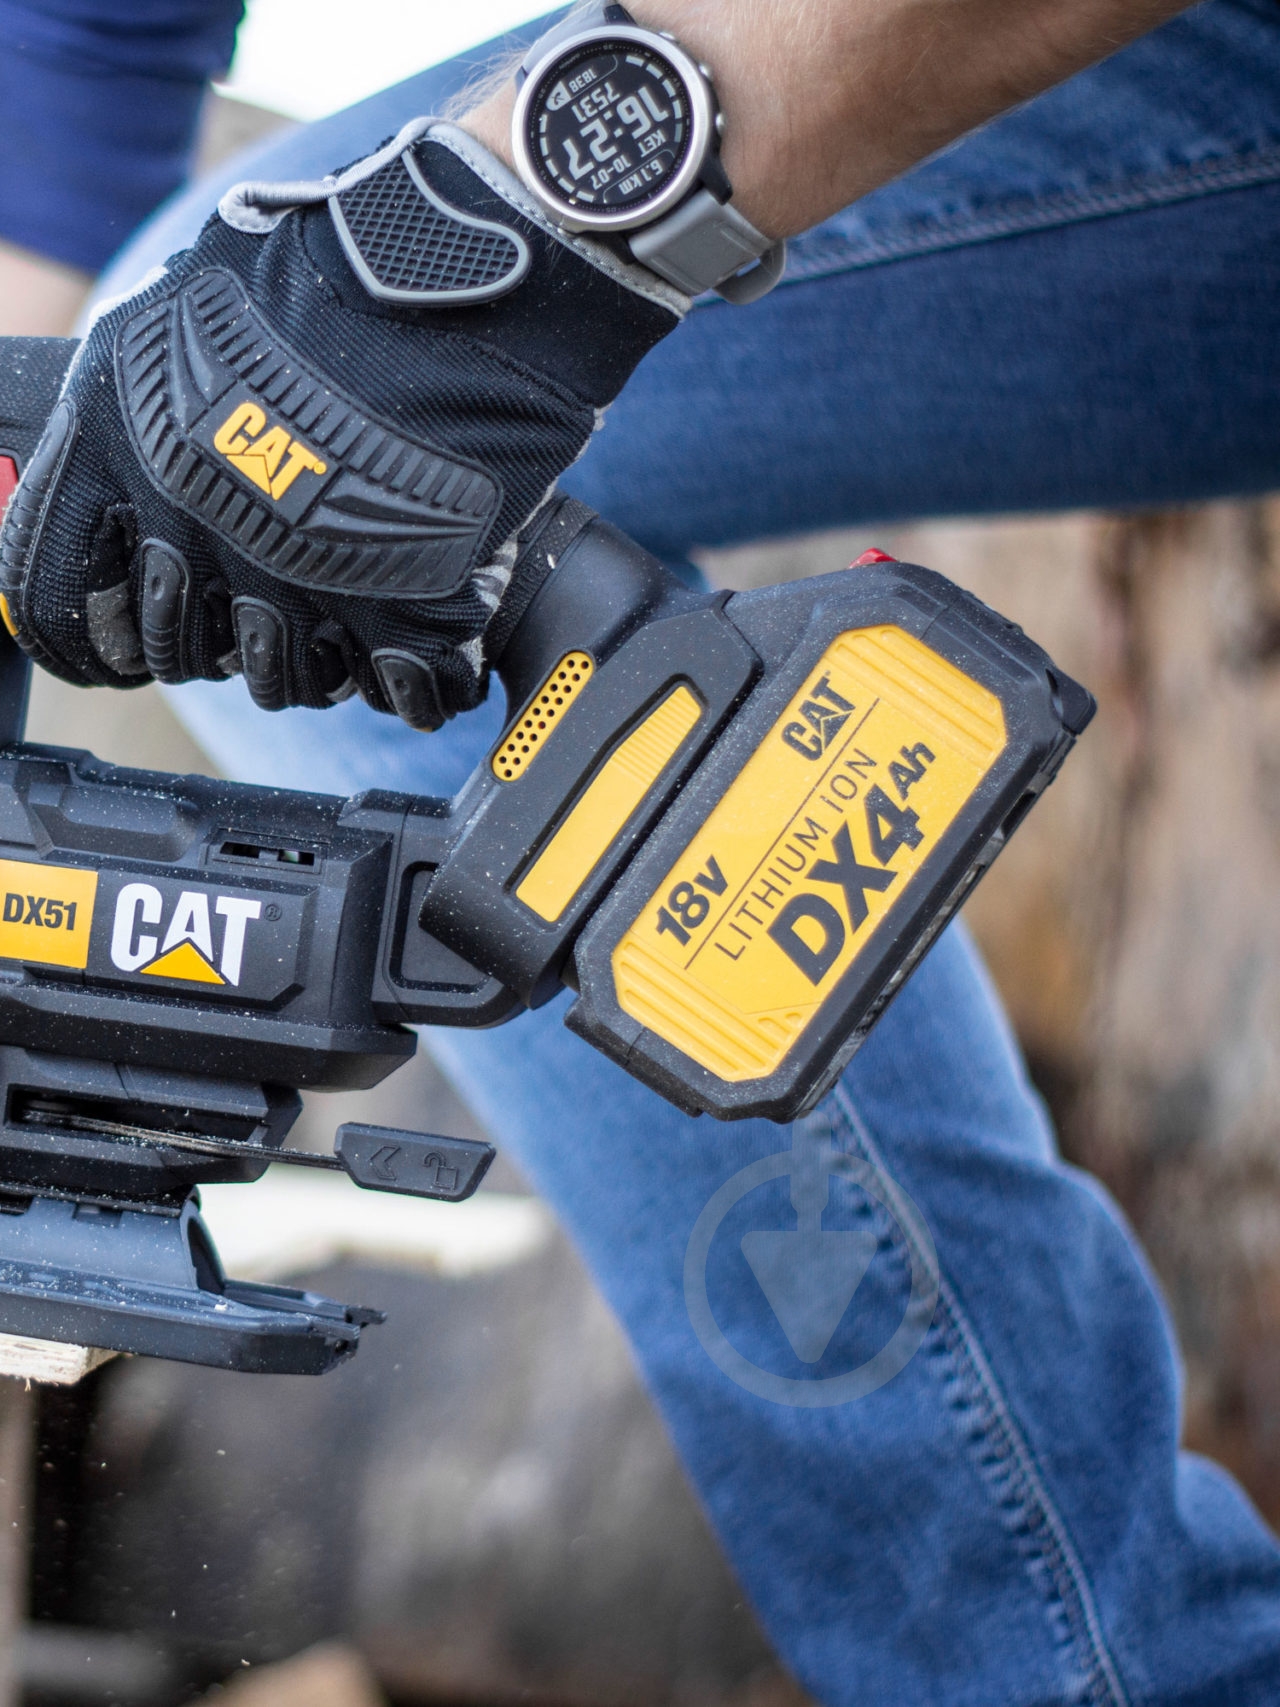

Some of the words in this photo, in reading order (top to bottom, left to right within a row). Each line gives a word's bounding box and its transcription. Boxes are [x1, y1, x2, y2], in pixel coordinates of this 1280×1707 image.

[568, 68, 597, 93] 1838
[571, 81, 621, 123] 7531
[562, 86, 669, 180] 16:27
[637, 129, 666, 158] KET
[591, 155, 632, 190] 10-07
[618, 174, 642, 195] km
[640, 159, 663, 181] 6.1
[214, 402, 323, 500] CAT
[781, 676, 856, 762] CAT
[714, 814, 829, 961] LITHIUM
[820, 747, 878, 813] ION
[2, 892, 78, 931] DX51
[110, 882, 262, 987] CAT
